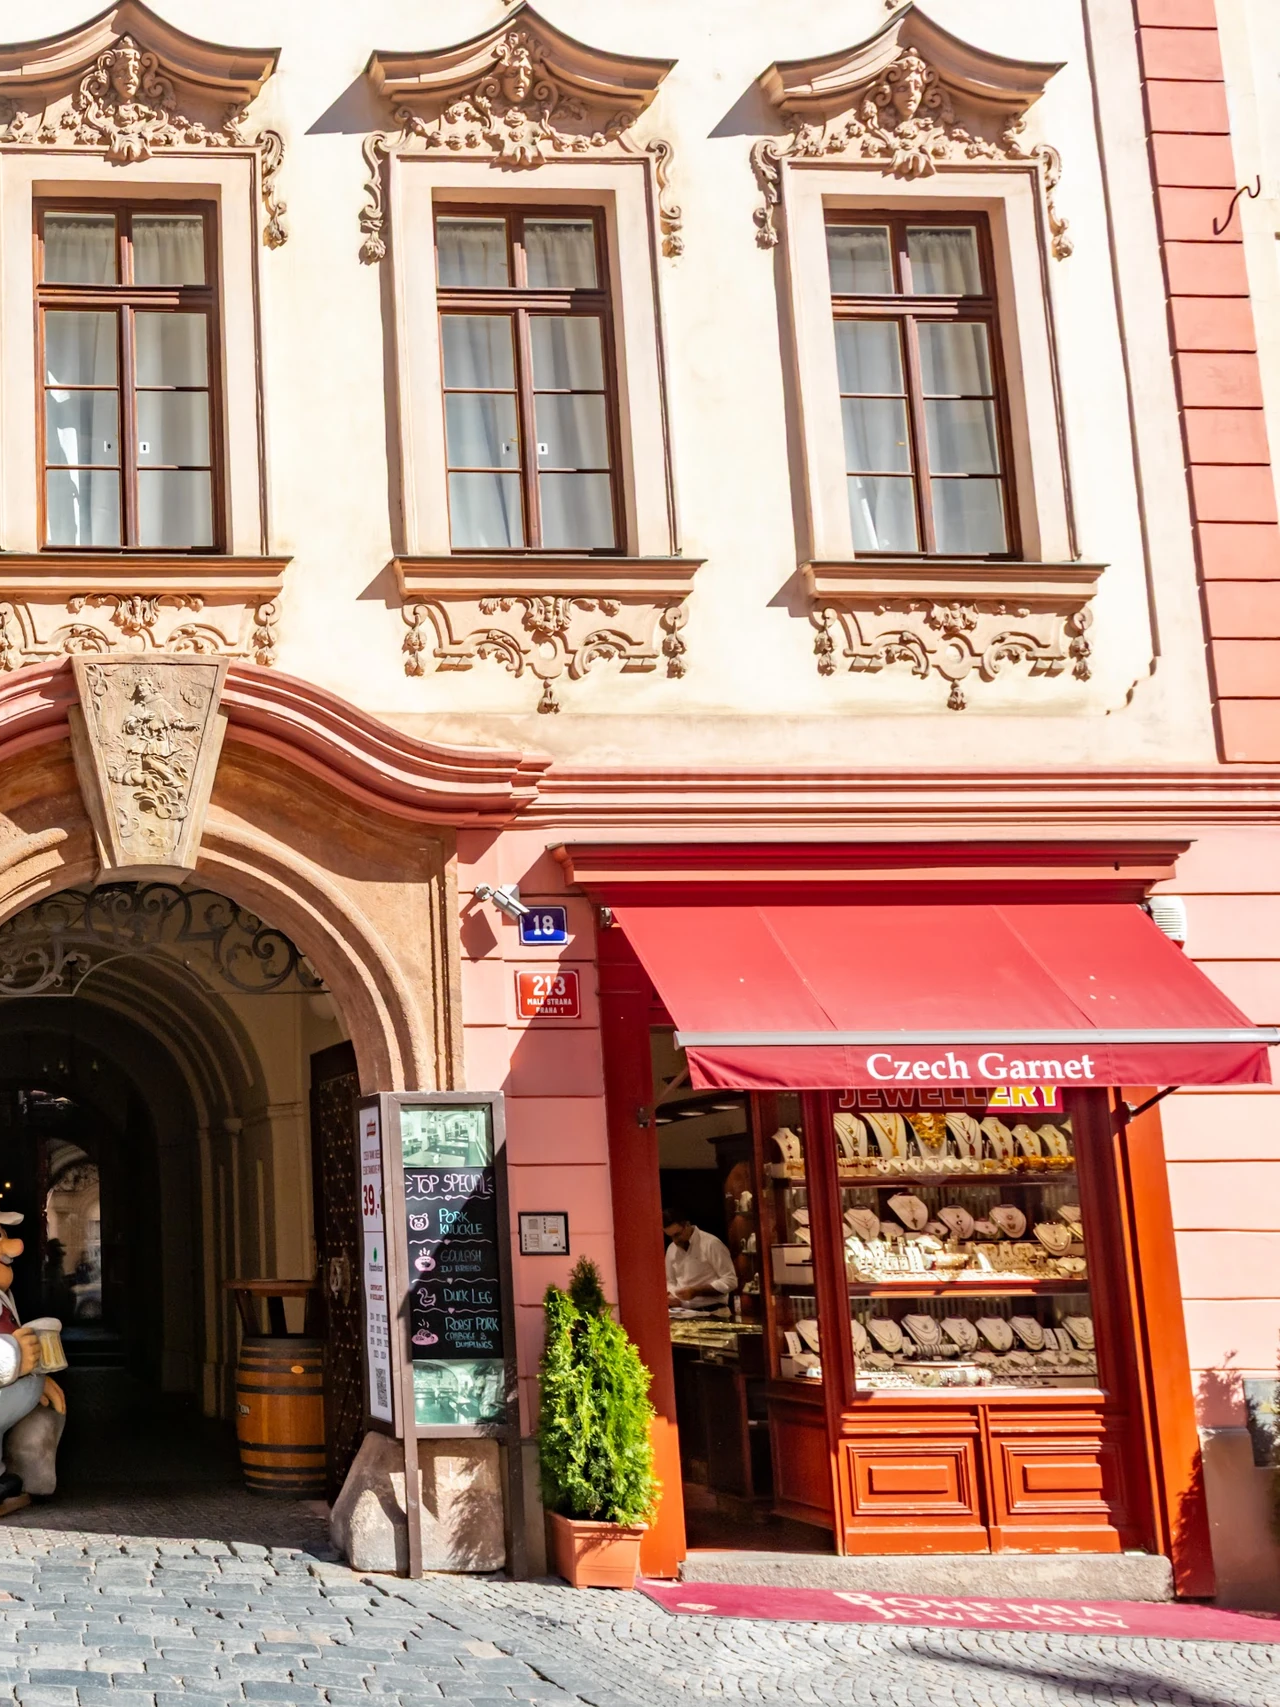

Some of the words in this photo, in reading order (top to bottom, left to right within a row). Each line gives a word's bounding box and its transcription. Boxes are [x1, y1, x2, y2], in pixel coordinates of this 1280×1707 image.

[533, 915, 554, 935] 18
[532, 975, 566, 996] 213
[527, 996, 544, 1005] MALÁ
[866, 1052, 971, 1080] Czech
[977, 1052, 1095, 1080] Garnet
[839, 1087, 1060, 1108] JEWELLERY
[412, 1174, 439, 1193] TOP
[441, 1173, 491, 1194] SPECIAL
[438, 1208, 469, 1224] PORK
[439, 1223, 483, 1236] KNUCKLE
[440, 1249, 482, 1263] GOULASH
[455, 1264, 481, 1272] BREAD
[443, 1288, 469, 1303] DUCK
[471, 1288, 493, 1304] LEG
[445, 1316, 473, 1331] ROAST
[475, 1316, 499, 1331] PORK
[832, 1591, 1122, 1618] BOHEMIA
[866, 1604, 1130, 1629] JEWELLERY
